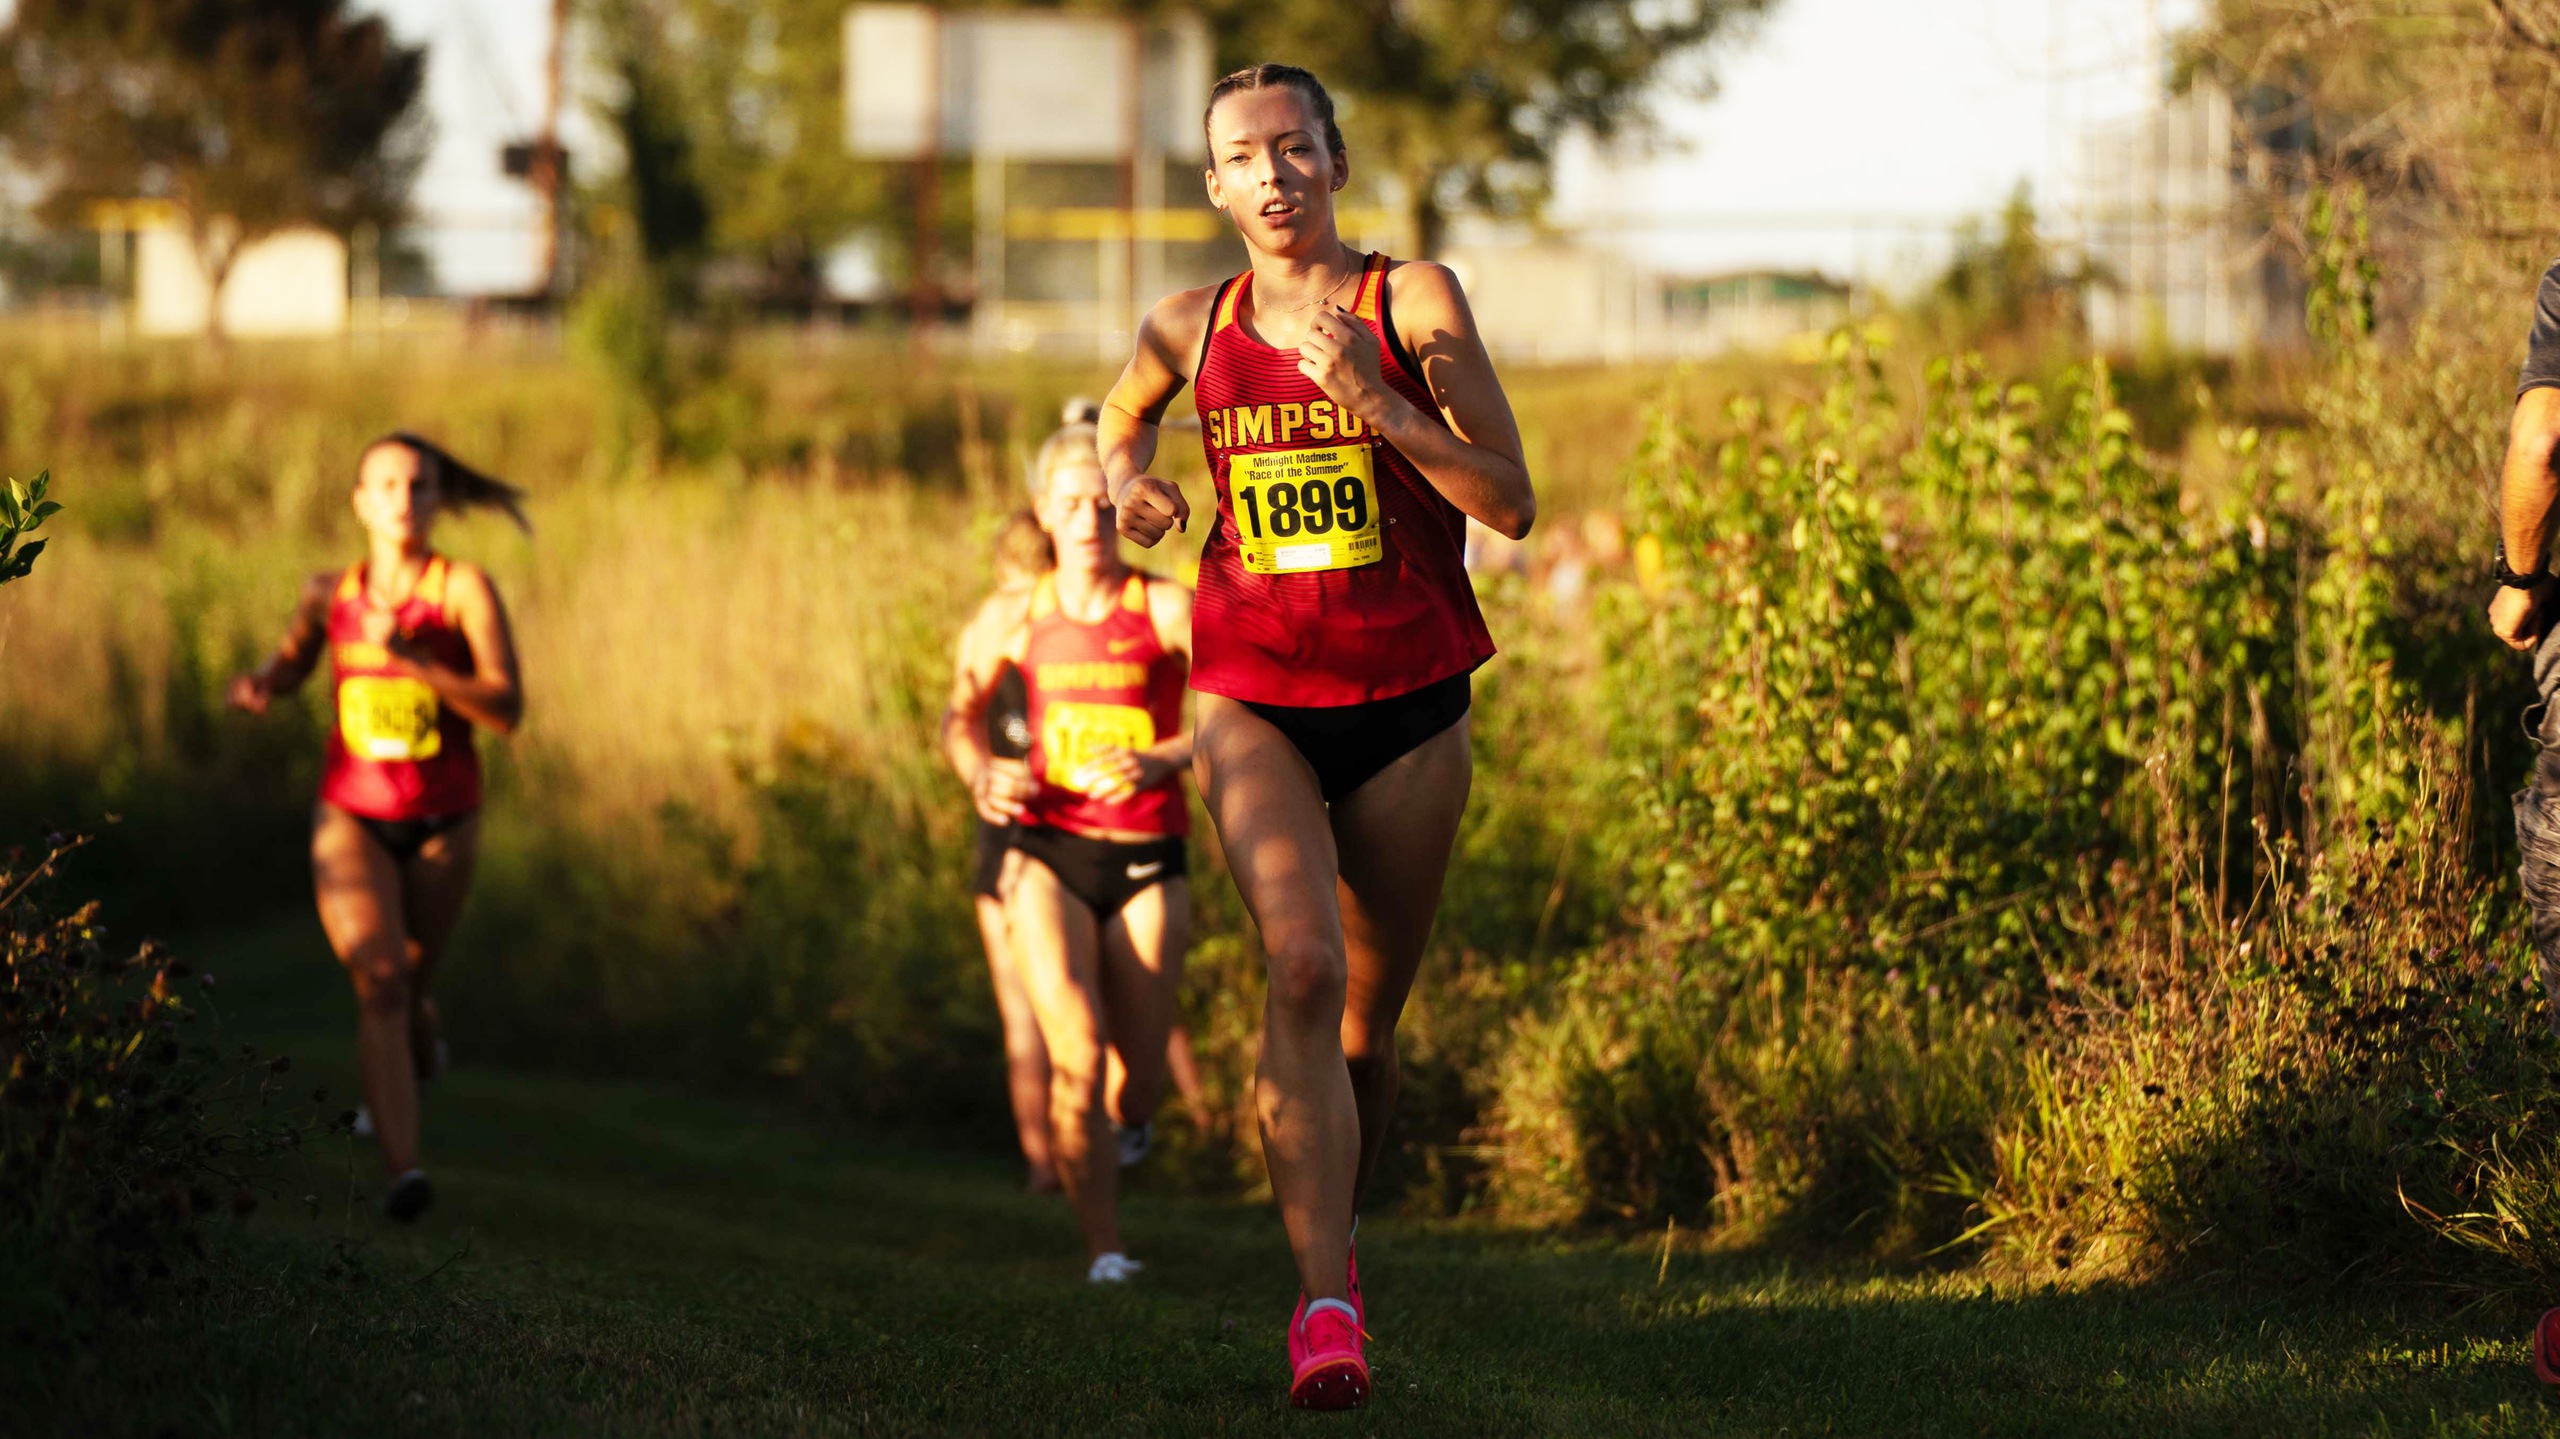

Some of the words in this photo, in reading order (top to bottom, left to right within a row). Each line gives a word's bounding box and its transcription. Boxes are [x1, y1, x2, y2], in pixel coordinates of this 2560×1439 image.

[1208, 400, 1382, 449] SIMPSO
[1244, 470, 1272, 481] "Race
[1275, 470, 1284, 479] of
[1287, 468, 1303, 478] the
[1305, 462, 1349, 475] Summer"
[1253, 456, 1293, 468] Midnight
[1296, 453, 1337, 464] Madness
[1239, 476, 1368, 538] 1899
